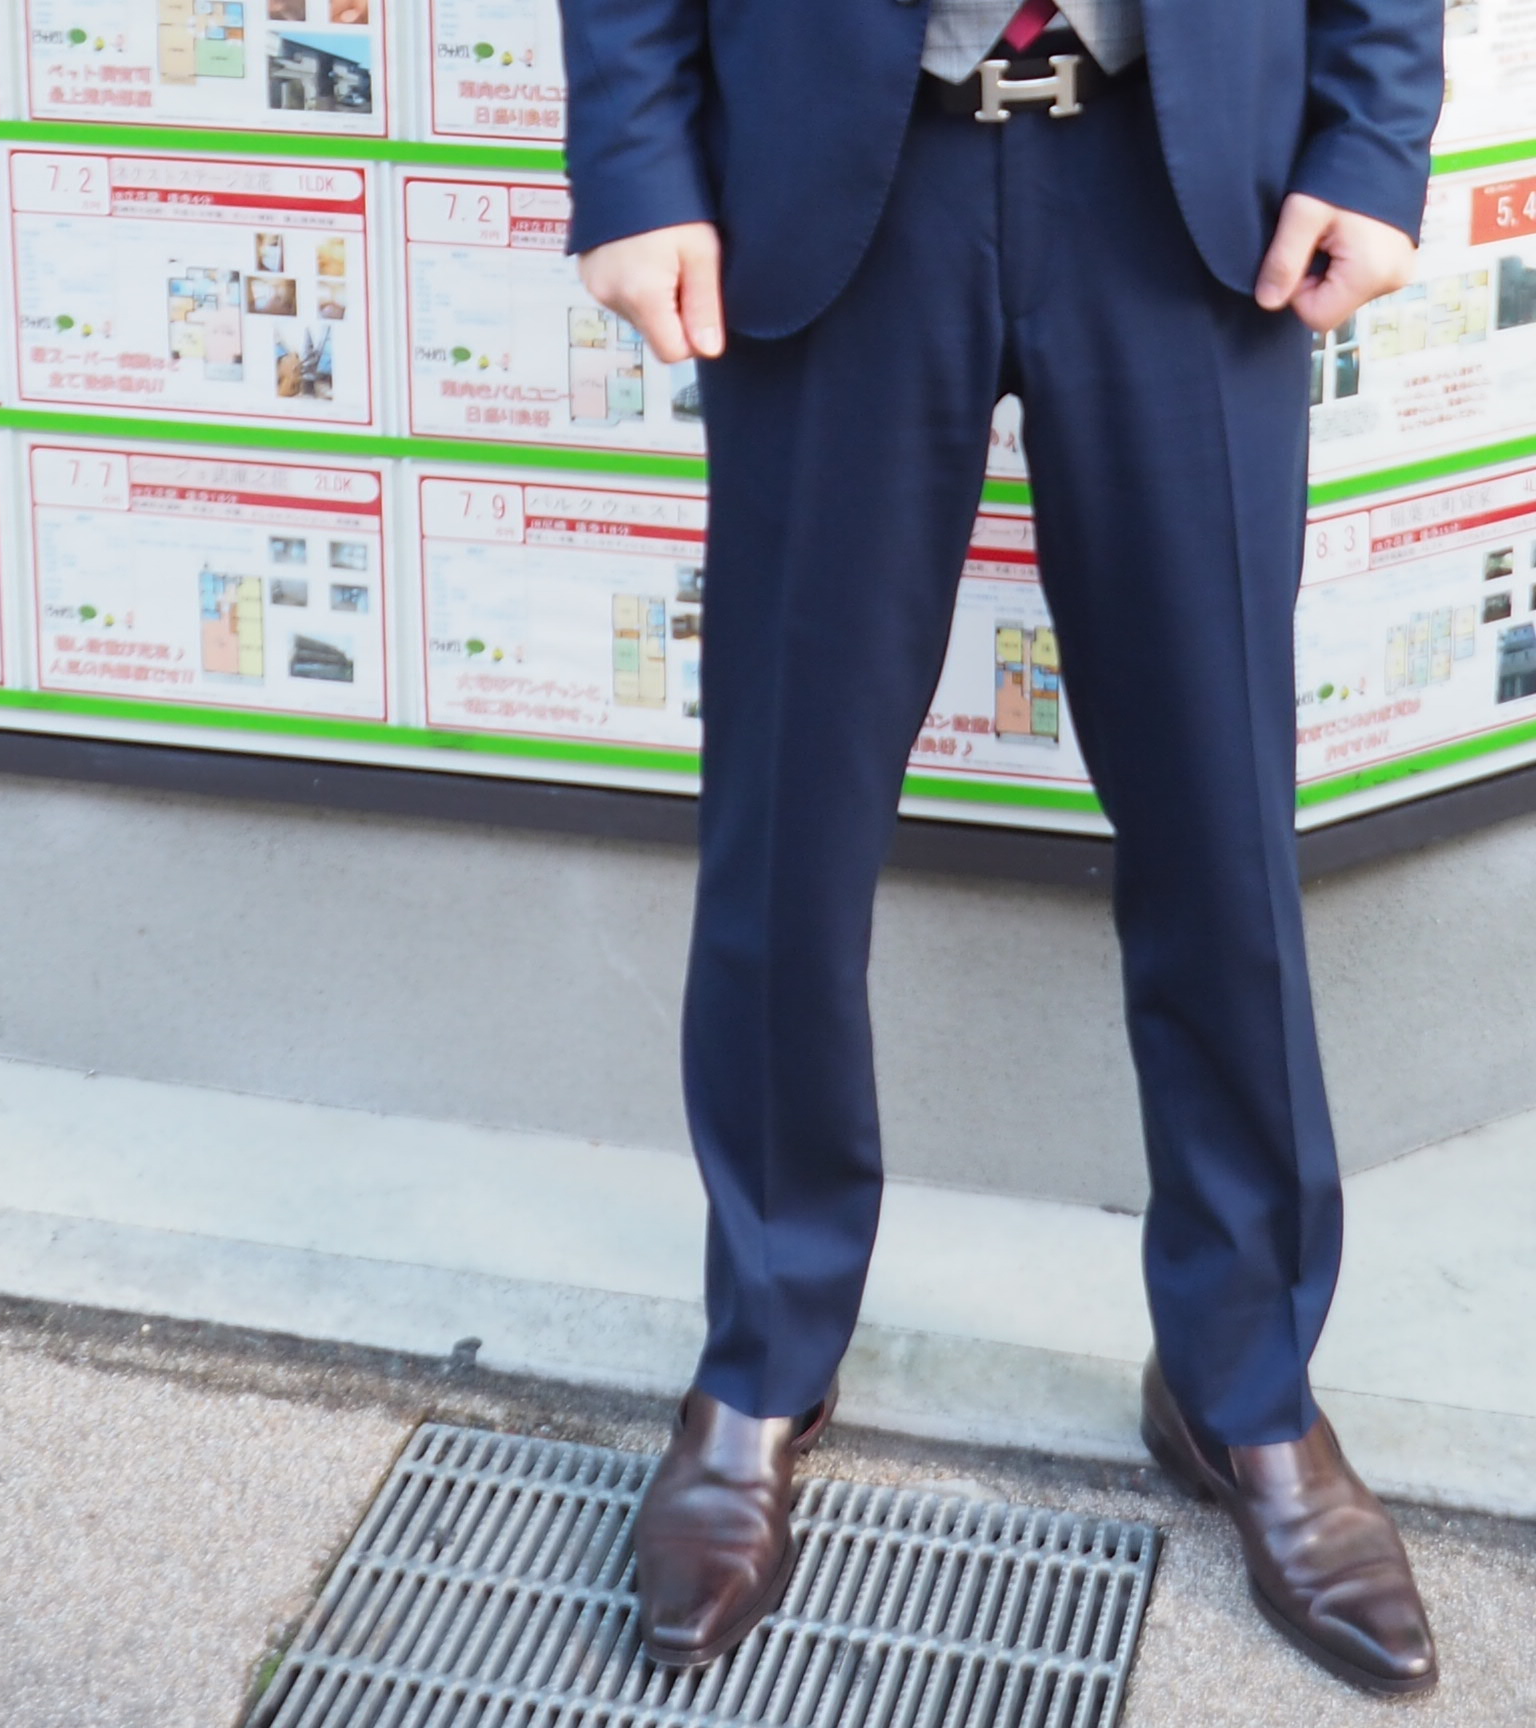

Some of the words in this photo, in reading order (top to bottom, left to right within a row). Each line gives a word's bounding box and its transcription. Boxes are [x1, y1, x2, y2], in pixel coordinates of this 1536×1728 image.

[46, 164, 93, 194] 7.2
[298, 174, 336, 192] 1LDK
[443, 192, 492, 223] 7.2
[67, 458, 113, 488] 7.7
[314, 473, 353, 494] 2LDK
[457, 489, 507, 520] 7.9
[1315, 525, 1357, 560] 8.3
